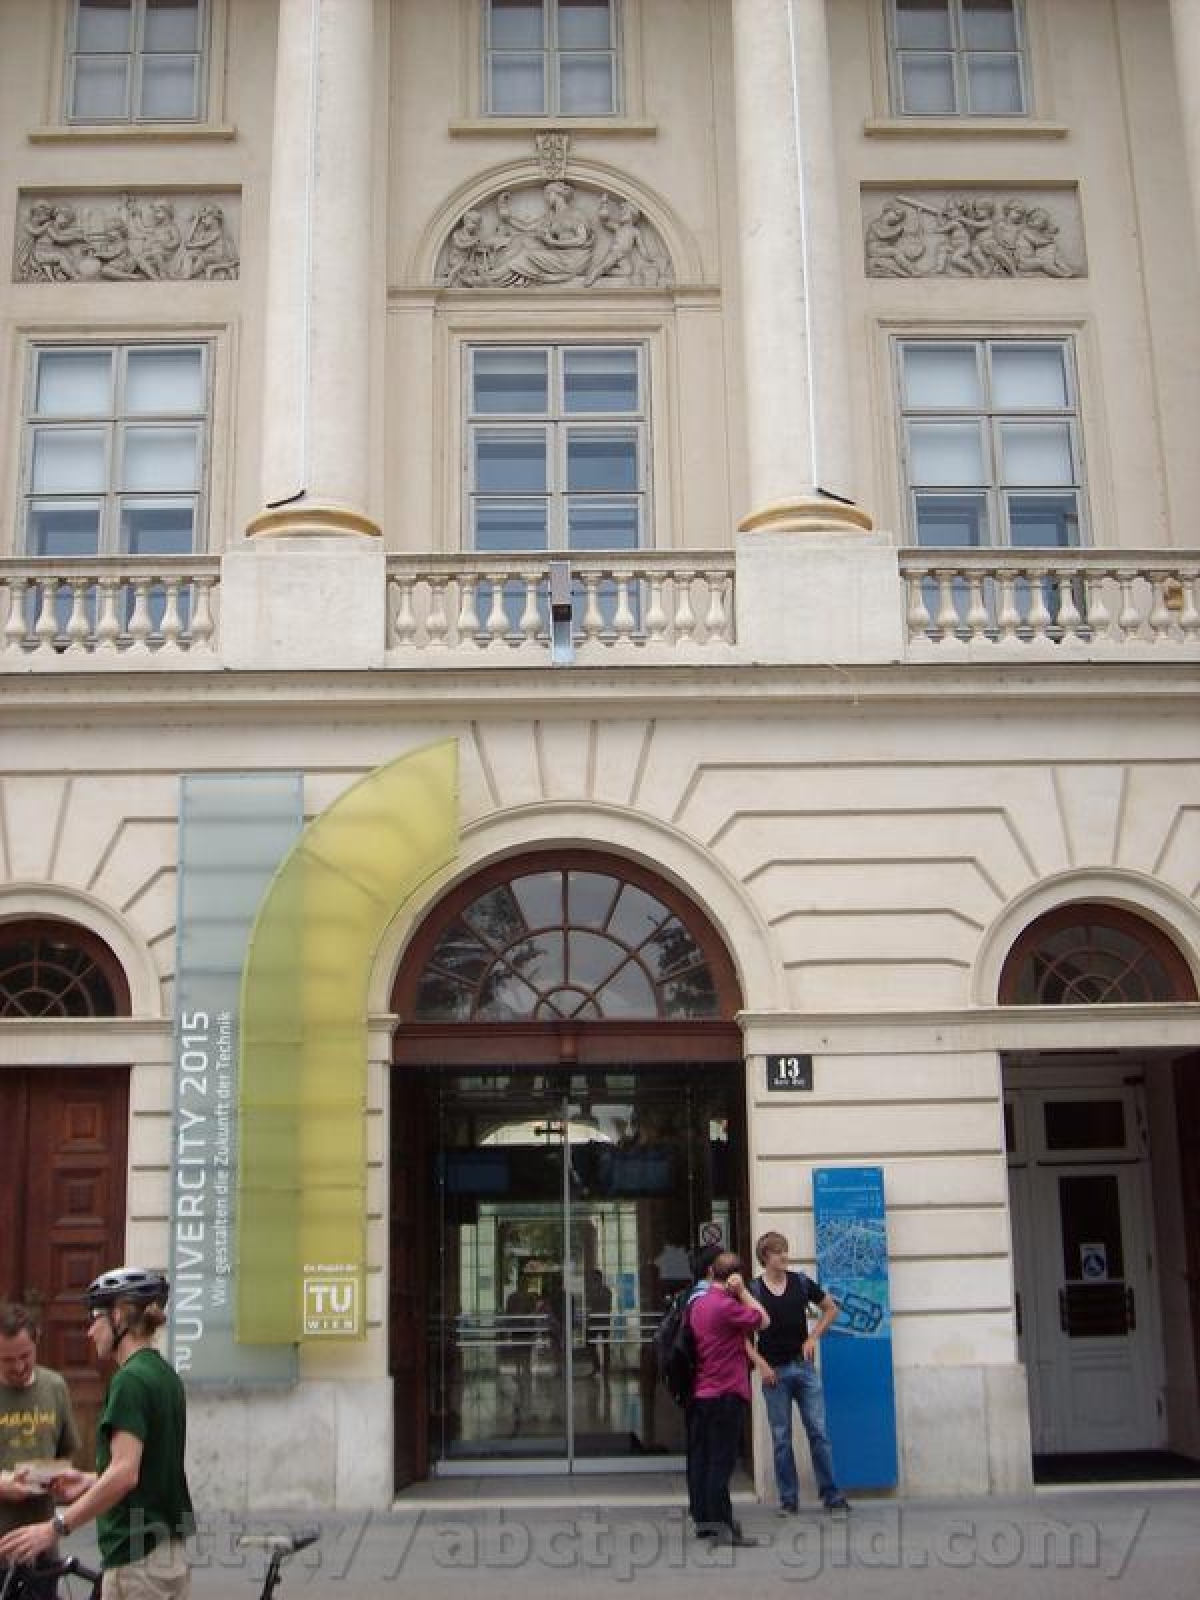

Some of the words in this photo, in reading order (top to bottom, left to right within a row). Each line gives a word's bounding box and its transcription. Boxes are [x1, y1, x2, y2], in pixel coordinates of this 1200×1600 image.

[181, 1010, 209, 1095] 2015
[216, 1010, 232, 1070] Technik
[778, 1057, 800, 1078] 13
[215, 1074, 231, 1100] der
[213, 1103, 231, 1166] Zukunft
[213, 1171, 230, 1195] die
[175, 1108, 206, 1341] UNIVERCITY
[211, 1200, 231, 1275] gestalten
[211, 1278, 227, 1307] Wir
[309, 1285, 352, 1313] TU
[175, 1346, 192, 1374] TU
